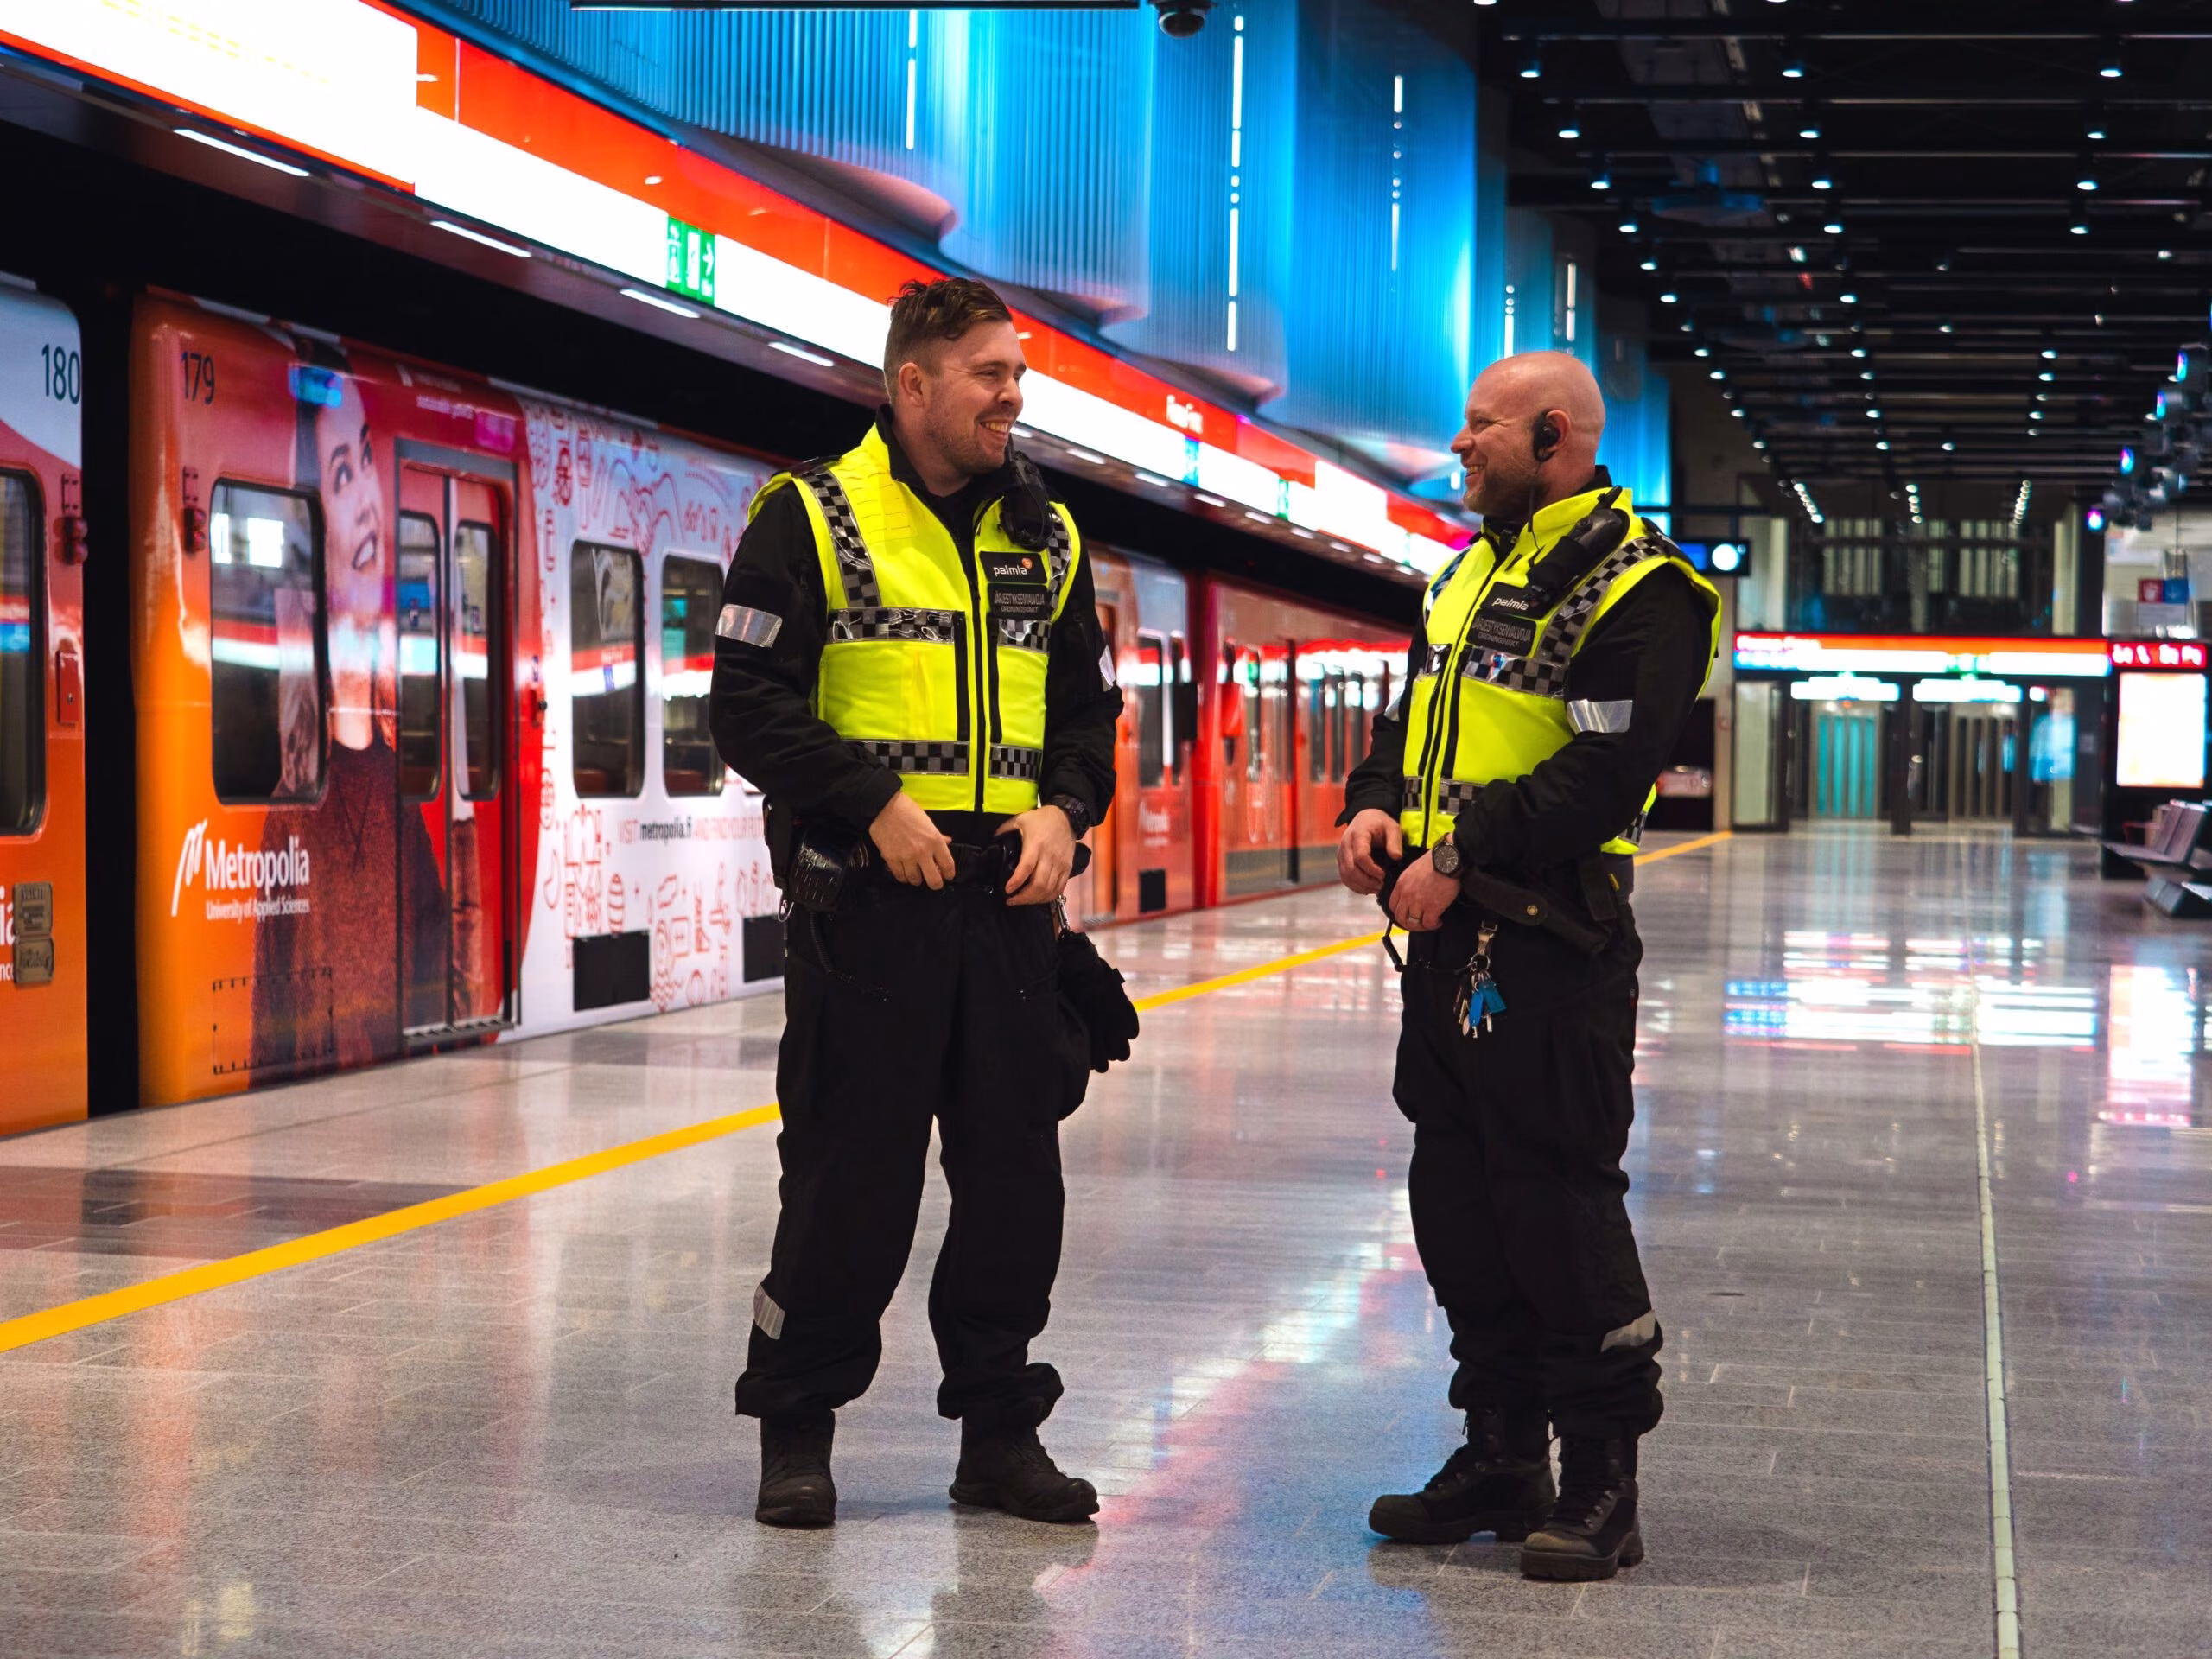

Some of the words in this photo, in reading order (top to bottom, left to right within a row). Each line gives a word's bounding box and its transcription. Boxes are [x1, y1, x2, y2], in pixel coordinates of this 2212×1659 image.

[41, 343, 81, 405] 180
[181, 350, 216, 405] 179
[993, 564, 1028, 577] palmia
[1491, 597, 1529, 611] palmia
[640, 815, 692, 846] metropolia.fi
[205, 835, 310, 897] Metropolia
[206, 898, 243, 925] University
[243, 895, 253, 918] of
[253, 895, 281, 923] Applied
[281, 894, 311, 916] Sciences
